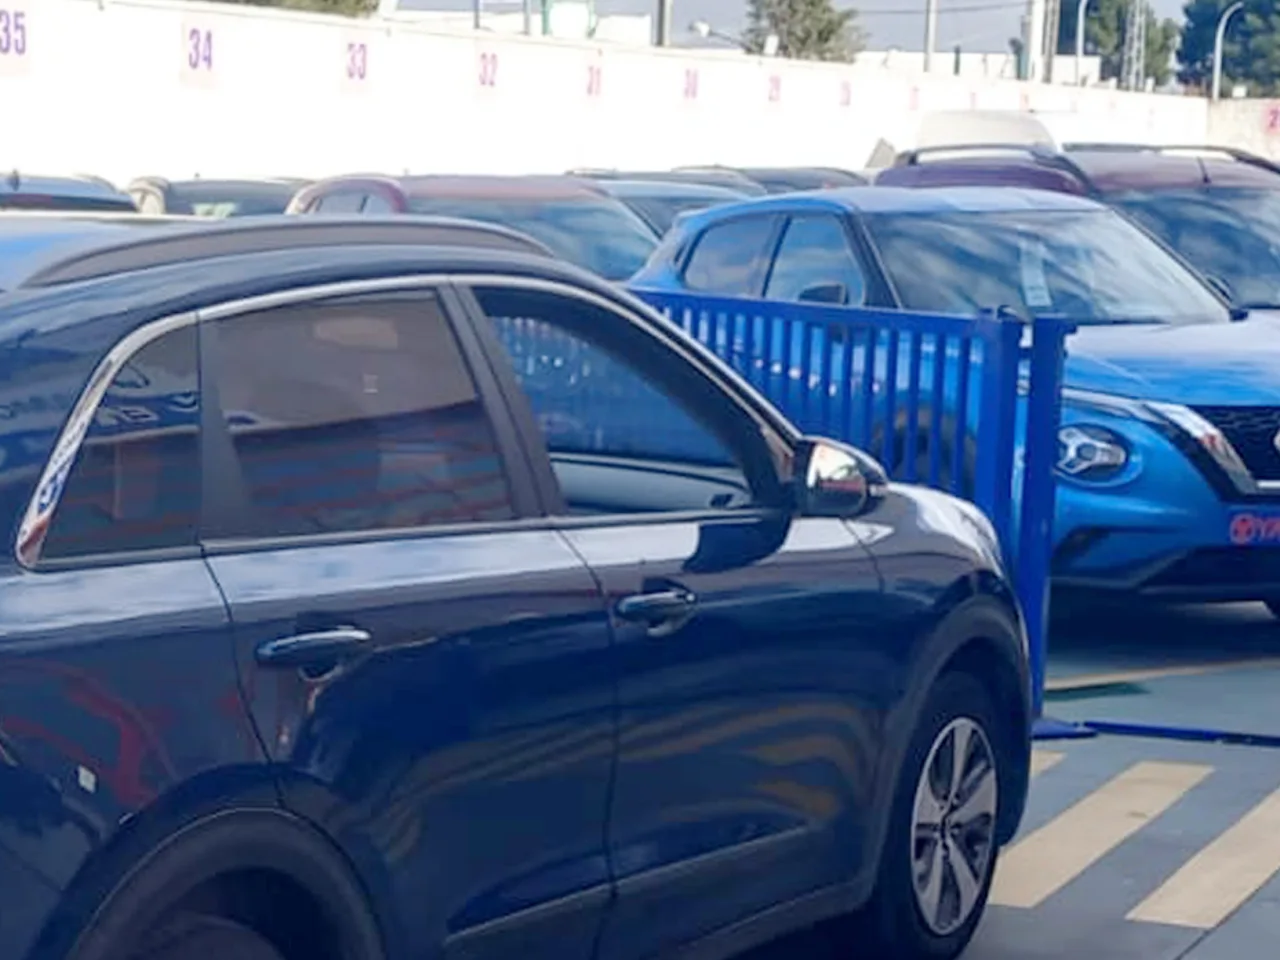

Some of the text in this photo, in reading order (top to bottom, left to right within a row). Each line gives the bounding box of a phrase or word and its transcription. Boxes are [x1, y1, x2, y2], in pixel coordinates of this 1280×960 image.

[188, 28, 212, 70] 34
[347, 43, 367, 80] 33
[479, 52, 498, 87] 32
